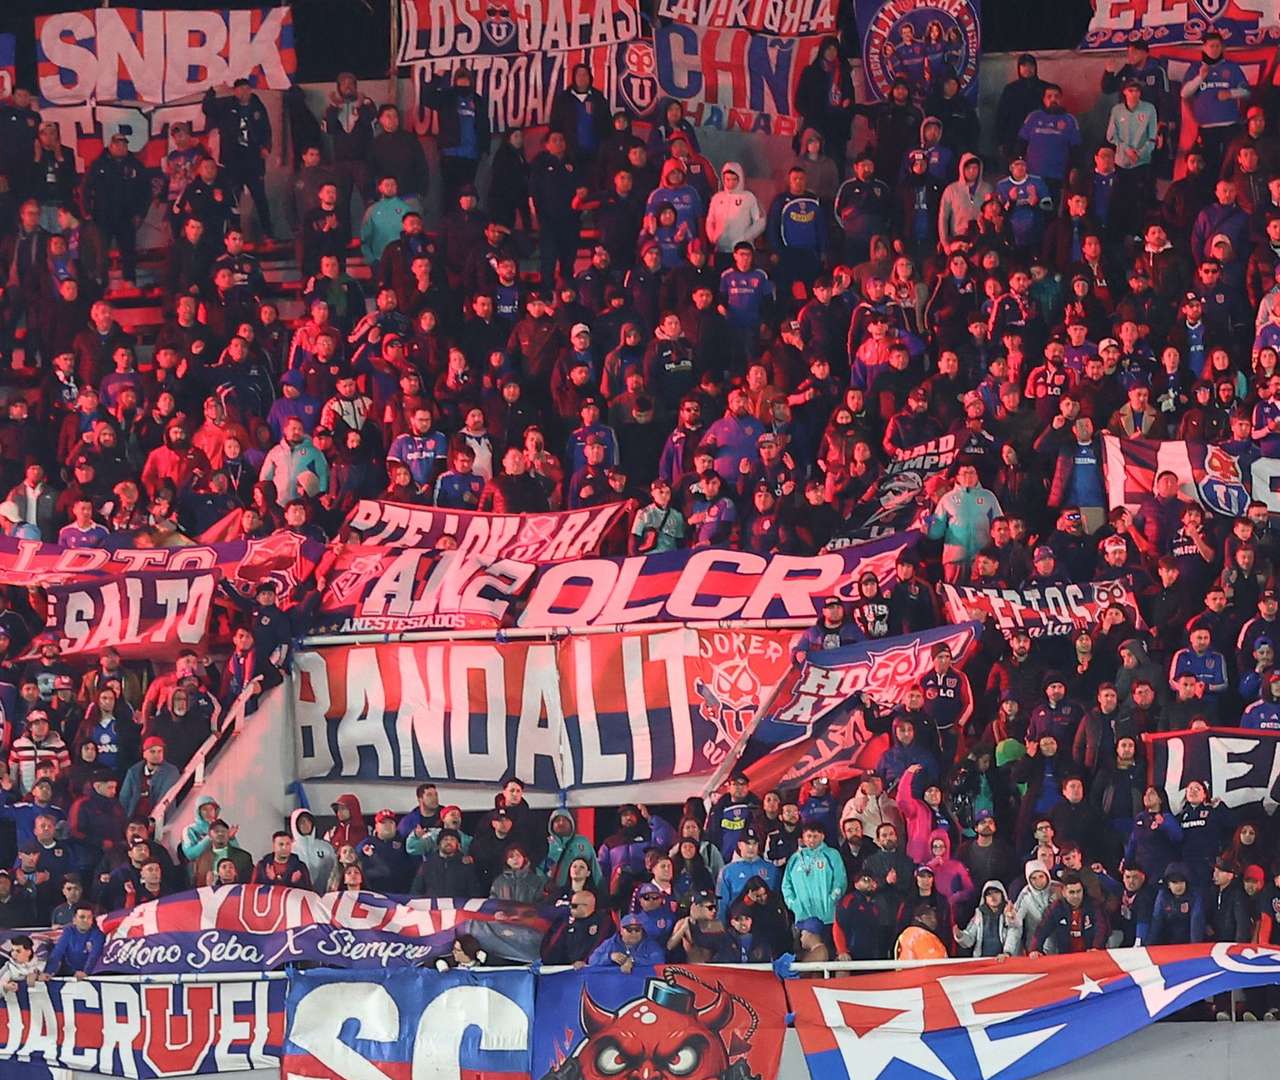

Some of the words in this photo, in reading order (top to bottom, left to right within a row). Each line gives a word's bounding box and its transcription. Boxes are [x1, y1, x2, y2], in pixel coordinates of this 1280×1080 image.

[40, 7, 292, 105] SNBK
[61, 573, 217, 654] SALTO
[340, 614, 467, 633] ANESTESIADOS
[699, 631, 784, 664] JOKER
[939, 689, 955, 698] LG
[188, 929, 265, 966] Seba
[266, 925, 306, 967] X
[316, 927, 433, 971] Siempre
